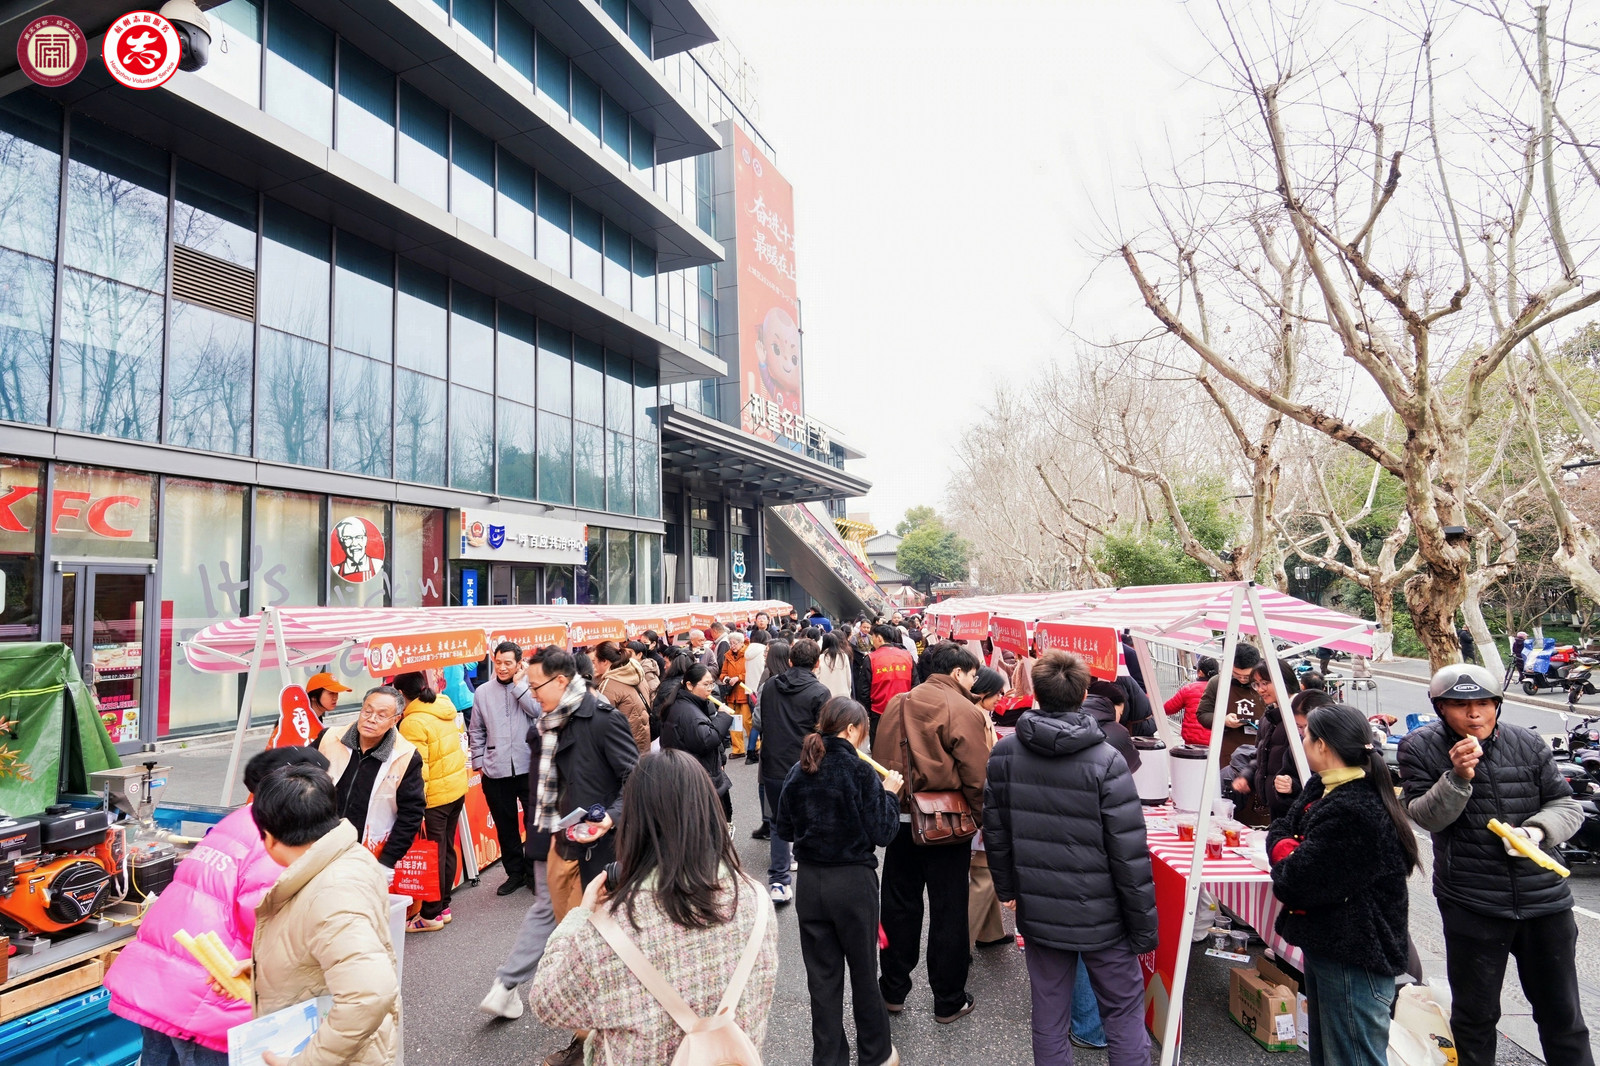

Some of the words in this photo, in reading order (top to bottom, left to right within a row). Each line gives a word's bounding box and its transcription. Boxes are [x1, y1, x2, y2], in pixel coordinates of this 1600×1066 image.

[750, 393, 830, 454] 利星名品广场
[0, 485, 141, 538] KFC
[506, 533, 585, 551] 一呼百应共治中心
[198, 545, 290, 618] It's
[397, 643, 432, 657] 奋进十五五
